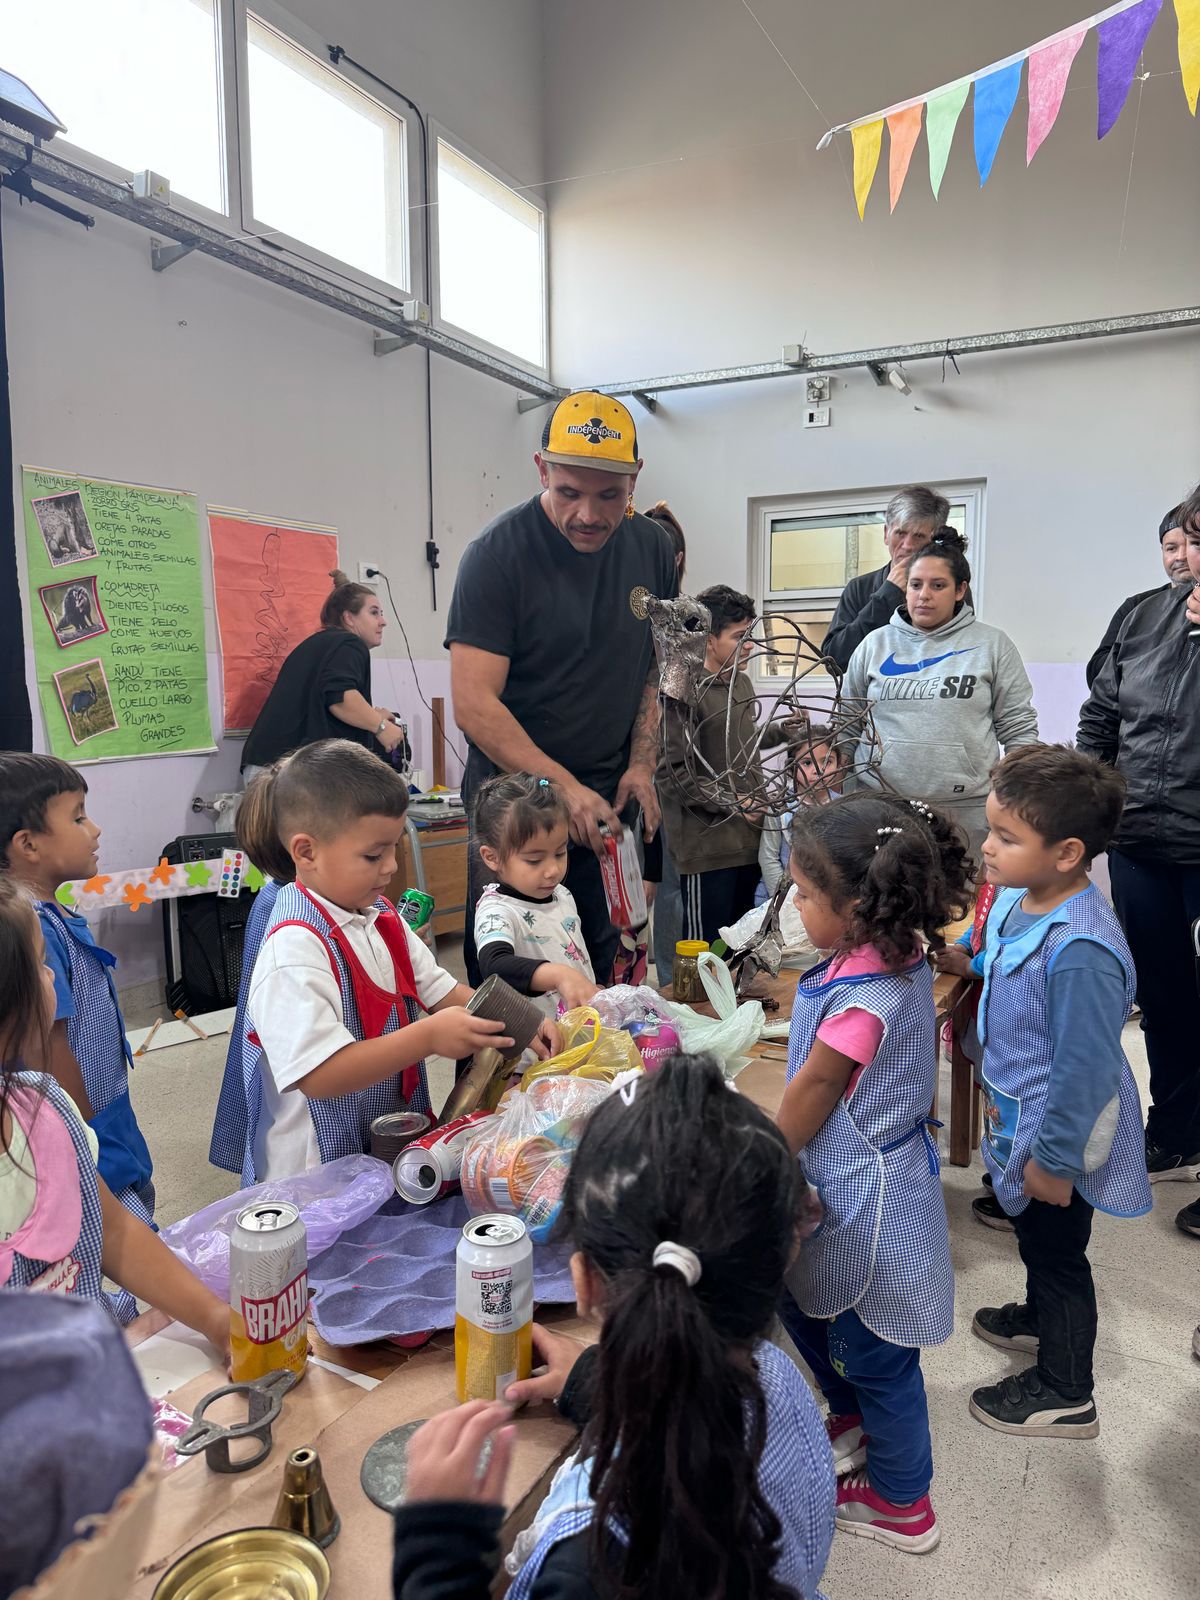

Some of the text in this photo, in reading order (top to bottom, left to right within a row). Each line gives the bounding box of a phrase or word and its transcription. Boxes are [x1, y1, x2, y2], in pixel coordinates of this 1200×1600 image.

[569, 425, 620, 439] INDEPENDENT
[34, 472, 80, 490] ANIMALES
[91, 496, 118, 507] ZORRO
[92, 508, 162, 525] TIENE 4 PATAS
[95, 522, 171, 539] OREJAS PARADAS
[98, 537, 157, 550] COME OTROS
[105, 560, 153, 574] Y FRUTAS
[104, 580, 160, 600] COMADREJA
[105, 600, 149, 611] DIENTES
[109, 615, 177, 627] TIENE PELO
[110, 629, 192, 639] COME HUEVOS
[111, 642, 146, 656] FRUTAS
[152, 666, 183, 677] TIENE
[144, 680, 152, 690] 2
[155, 679, 189, 690] PATAS
[880, 674, 977, 700] NIKE SB
[119, 694, 193, 709] CUELLO LARGO
[122, 711, 166, 726] PLUMAS
[141, 725, 186, 742] GRANDES
